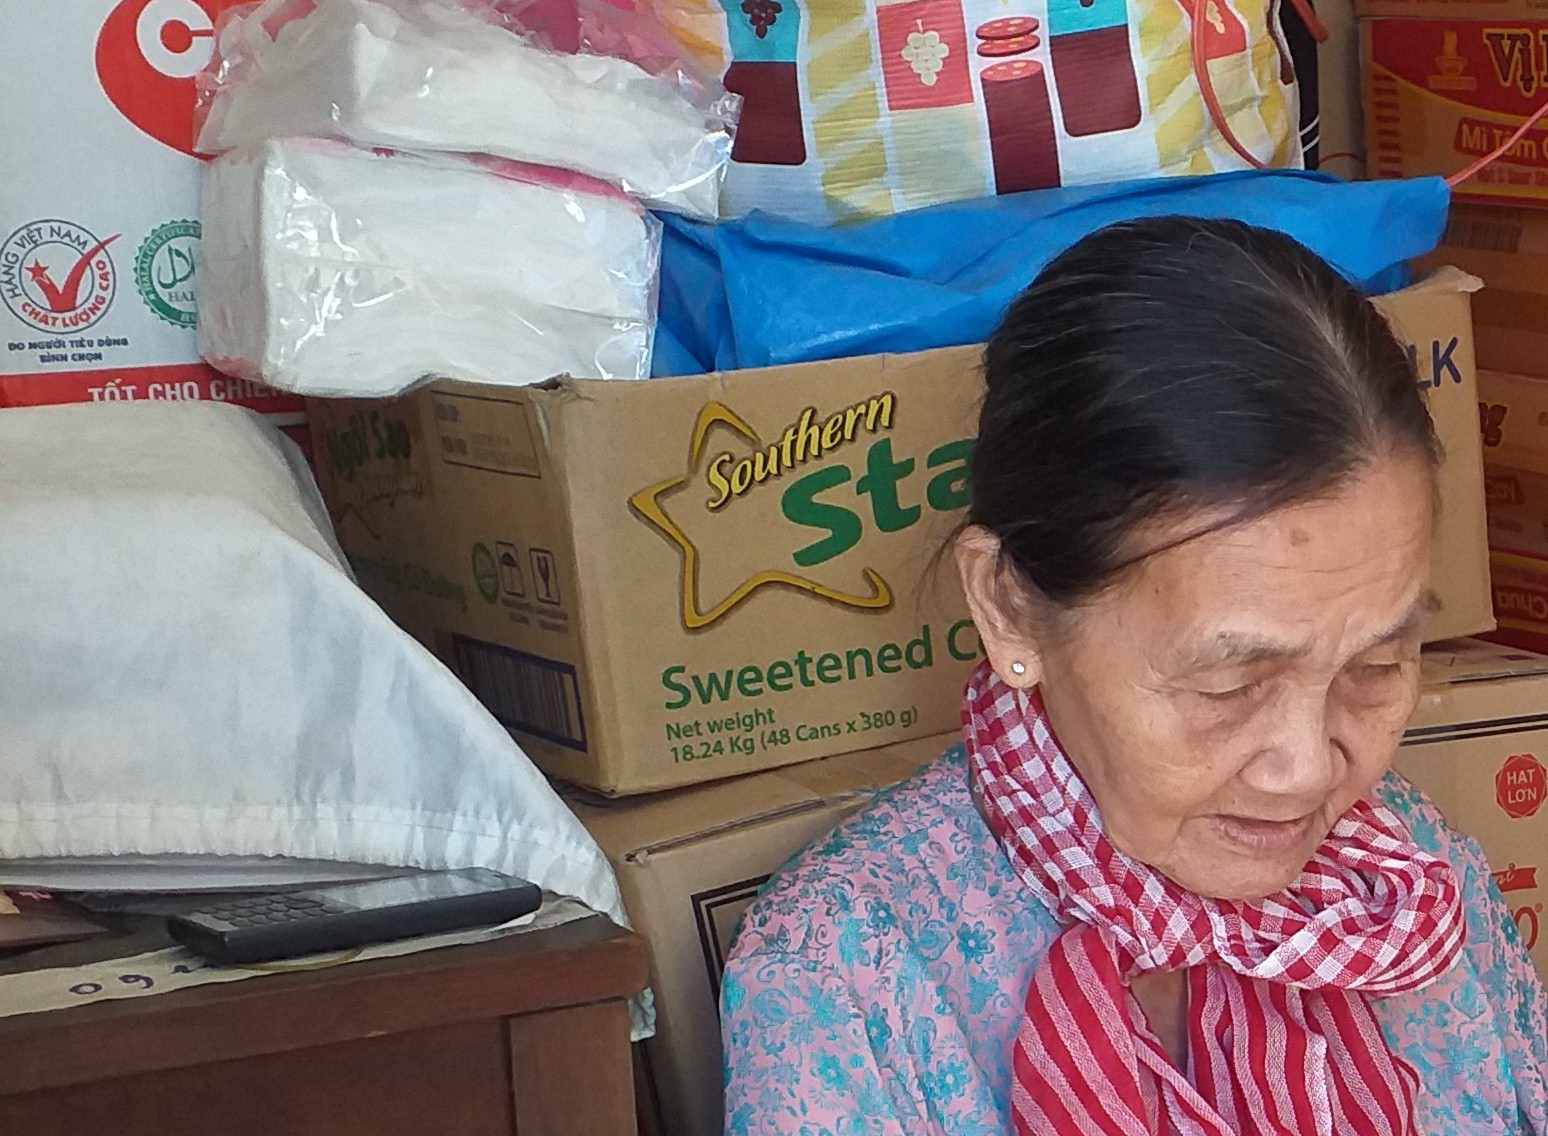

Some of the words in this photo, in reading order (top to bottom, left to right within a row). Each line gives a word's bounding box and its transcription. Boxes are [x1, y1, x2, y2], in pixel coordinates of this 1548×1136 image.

[1486, 33, 1533, 93] Vị
[50, 226, 90, 250] NAM
[95, 259, 110, 292] CAO
[147, 381, 200, 401] CHO
[709, 392, 895, 509] Southern
[661, 627, 933, 711] Sweetened
[667, 721, 702, 742] Net
[707, 708, 775, 740] weight
[670, 741, 725, 763] 18.24
[730, 735, 754, 758] Kg
[760, 728, 791, 753] (48
[796, 721, 841, 744] Cans
[862, 711, 895, 733] 380
[900, 705, 918, 729] g)
